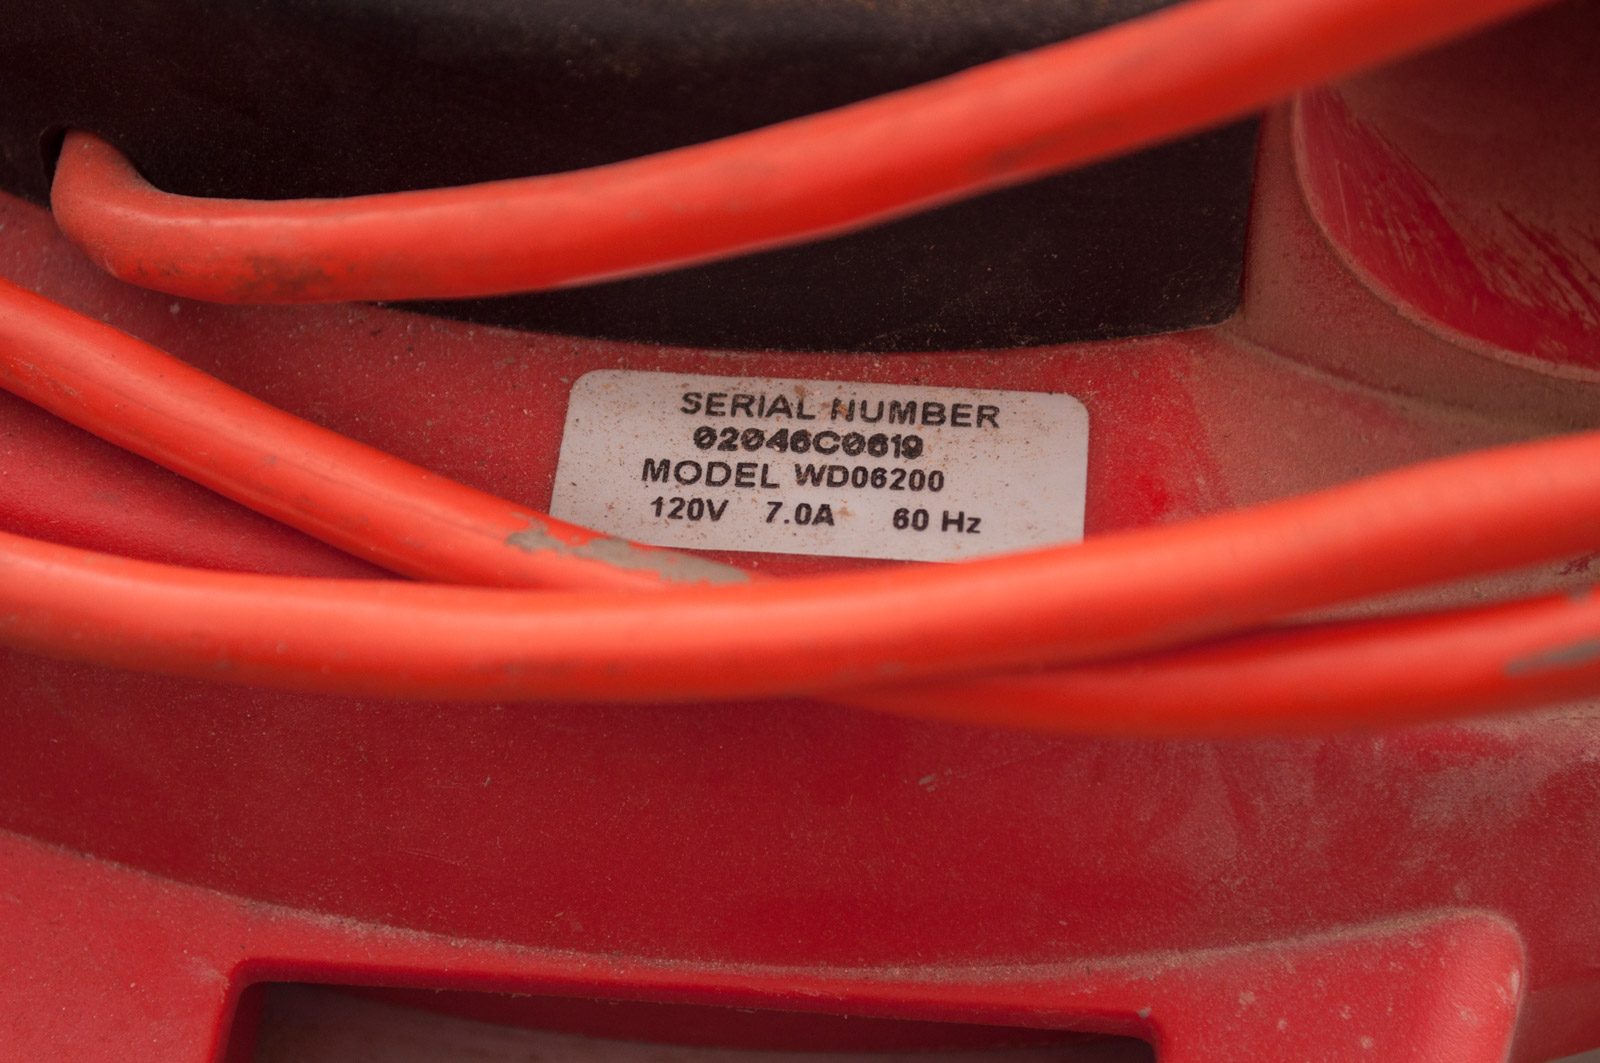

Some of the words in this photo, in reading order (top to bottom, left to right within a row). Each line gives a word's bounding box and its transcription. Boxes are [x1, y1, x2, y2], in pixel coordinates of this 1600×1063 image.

[680, 391, 817, 420] SERIAL
[830, 399, 1001, 429] NUMBER
[641, 458, 780, 490] MODEL
[794, 463, 946, 493] WD06200
[649, 495, 729, 523] 120V
[765, 501, 835, 526] 7.0A
[892, 508, 930, 532] 60
[941, 510, 983, 535] Hz
